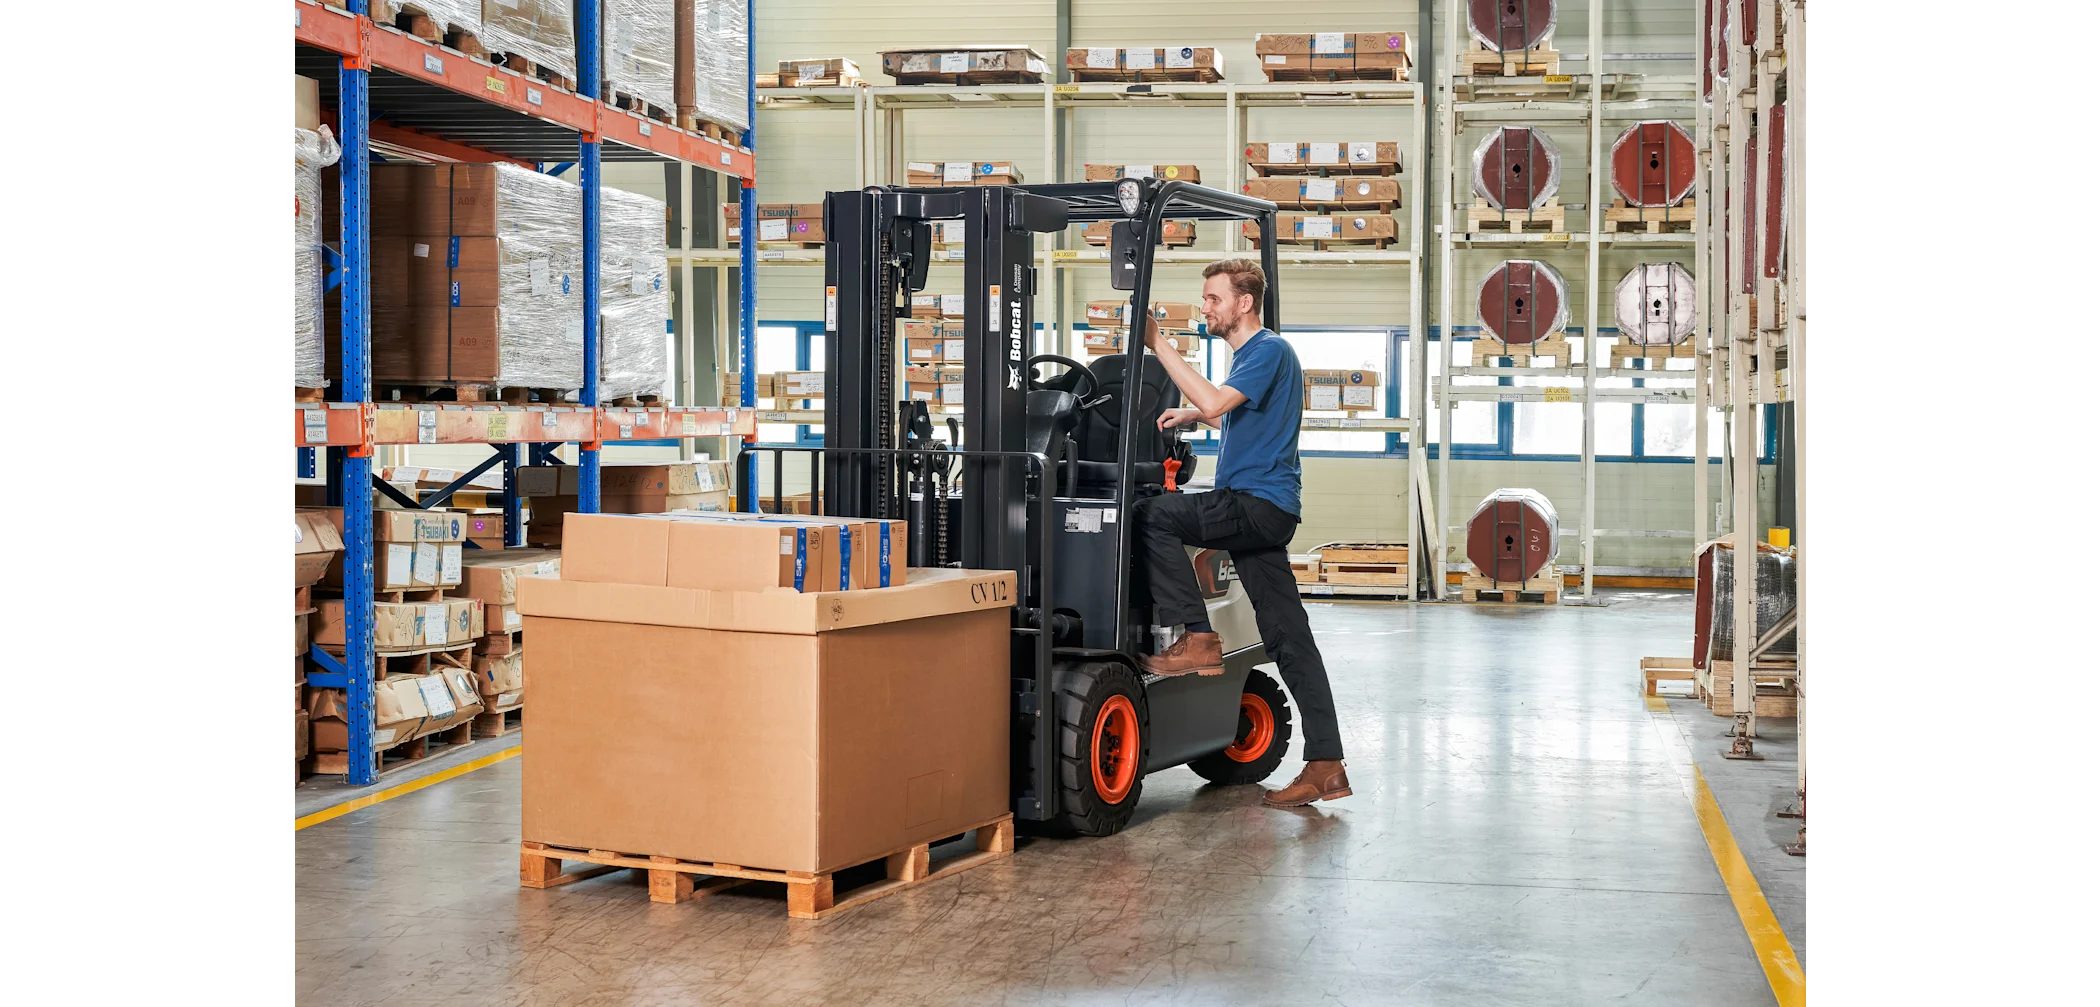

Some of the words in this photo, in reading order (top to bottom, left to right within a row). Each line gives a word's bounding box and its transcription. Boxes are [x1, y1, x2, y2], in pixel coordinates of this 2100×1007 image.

[458, 197, 475, 206] A09
[762, 209, 798, 217] TSUBAKI
[1010, 300, 1021, 362] Bobcat
[459, 337, 477, 346] A09
[421, 524, 449, 539] TSUBAKI
[971, 582, 988, 605] CV
[991, 580, 1007, 602] 1/2
